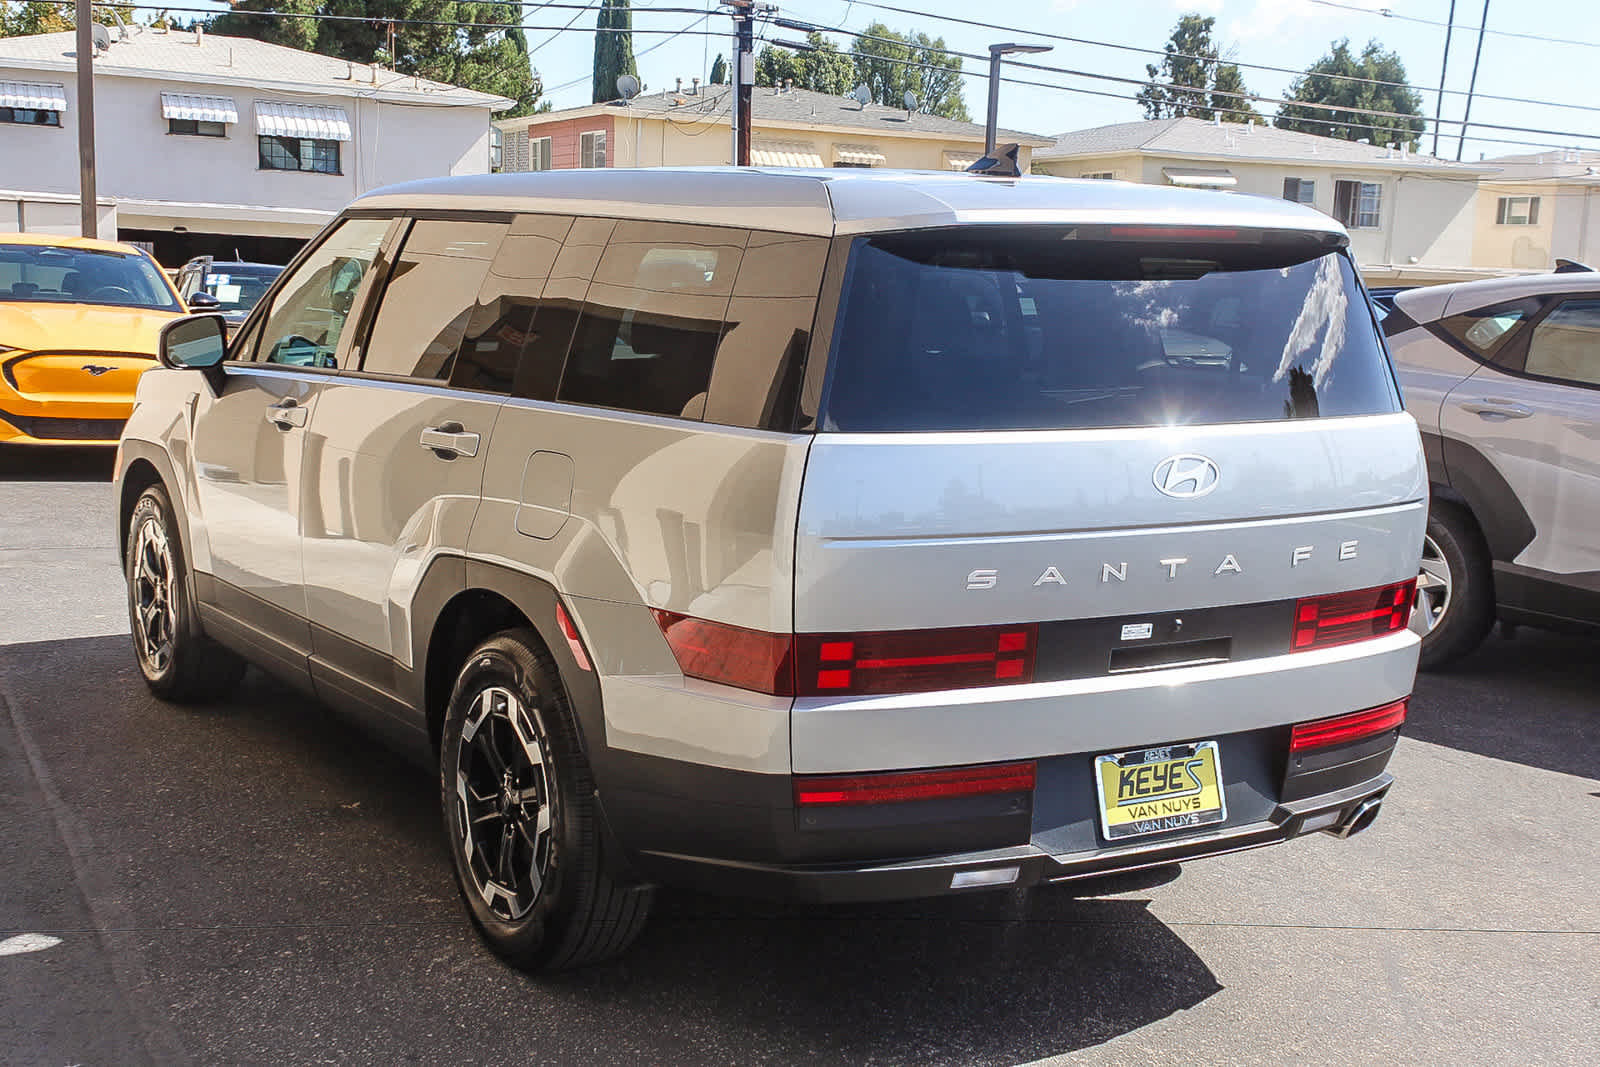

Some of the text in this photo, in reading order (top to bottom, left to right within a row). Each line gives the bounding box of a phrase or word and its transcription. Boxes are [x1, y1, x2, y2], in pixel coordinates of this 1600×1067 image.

[966, 540, 1359, 590] SANTA FE
[1118, 759, 1204, 799] KEYES
[1128, 798, 1201, 818] VAN NUYS
[1134, 814, 1200, 833] VAN NUYS
